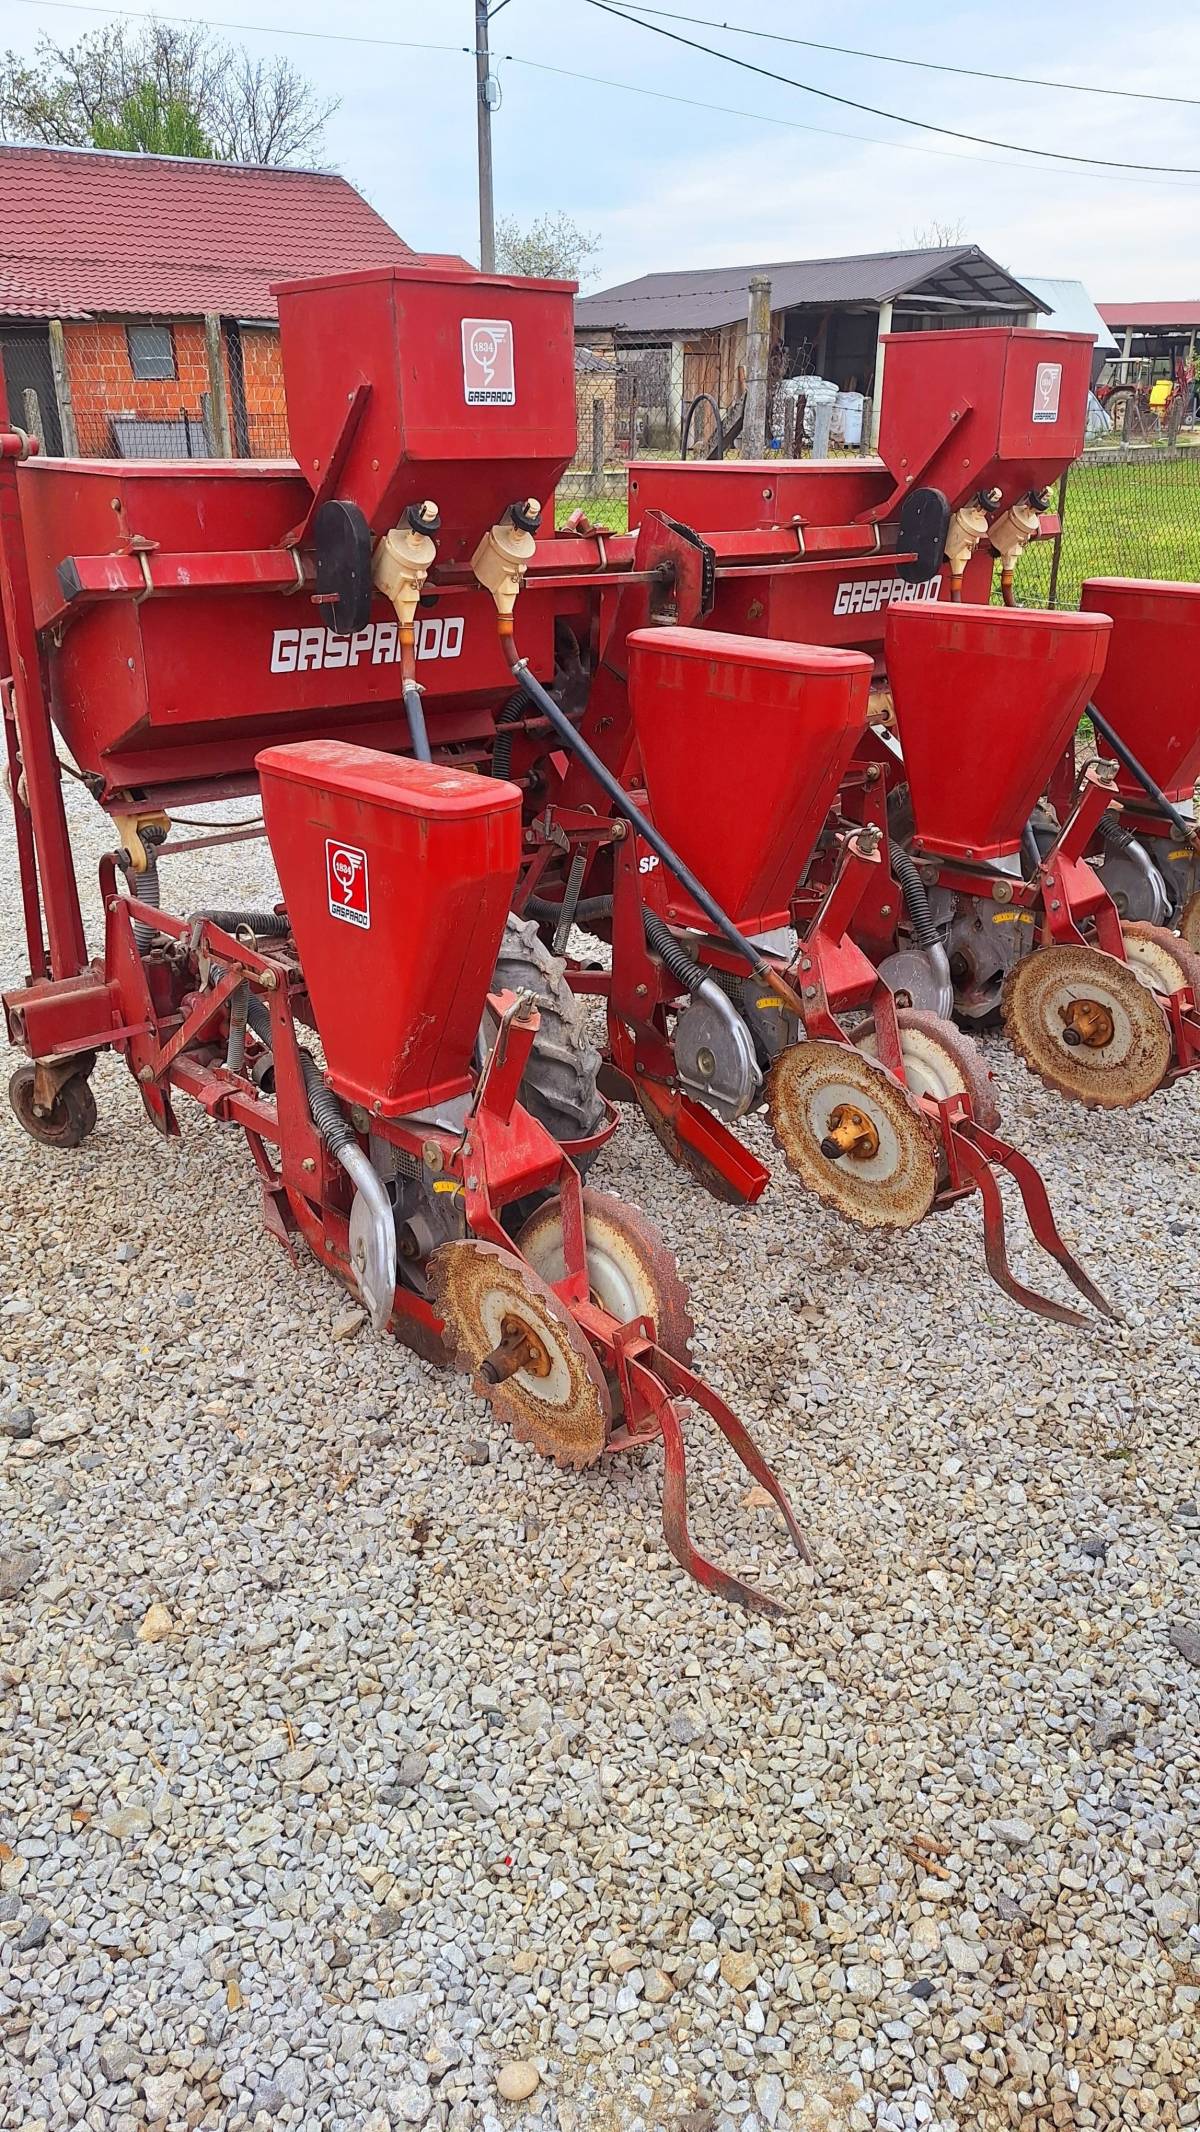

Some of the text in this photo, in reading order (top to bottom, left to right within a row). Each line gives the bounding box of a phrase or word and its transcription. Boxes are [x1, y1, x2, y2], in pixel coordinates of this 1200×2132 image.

[474, 342, 494, 352] 1834
[468, 391, 513, 402] GASPARDO
[270, 617, 464, 673] GASPADO
[332, 904, 368, 926] GASPARDO
